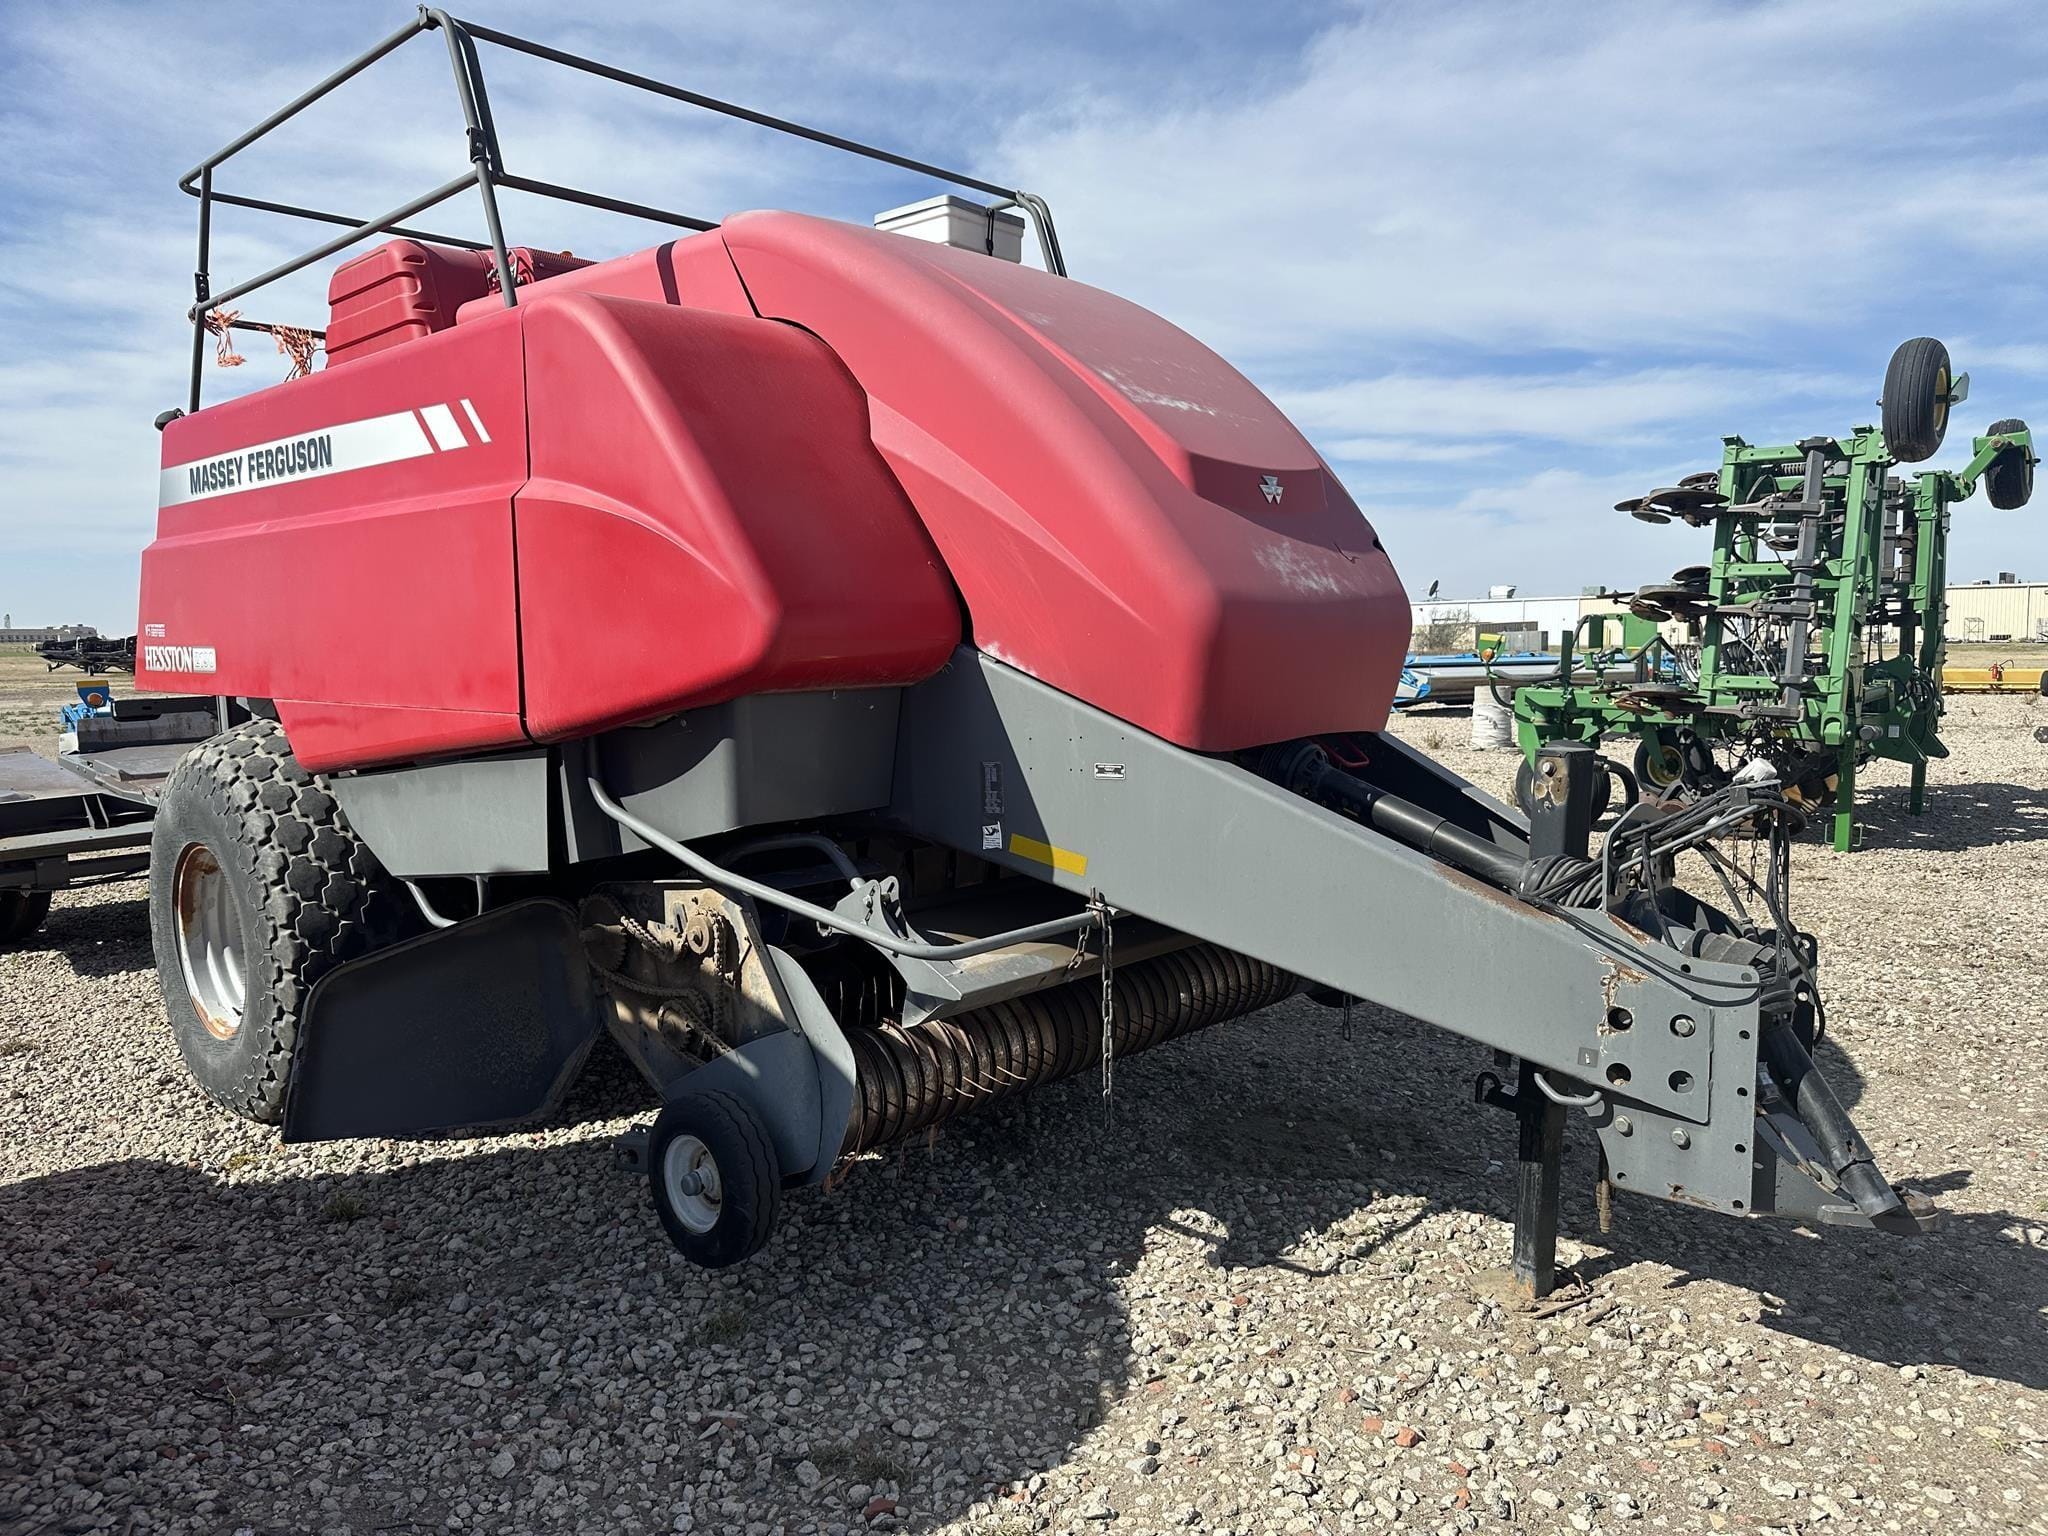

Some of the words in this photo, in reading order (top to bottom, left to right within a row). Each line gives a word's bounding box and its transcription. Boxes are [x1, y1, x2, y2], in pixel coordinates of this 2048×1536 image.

[189, 455, 243, 495] MASSEY
[247, 434, 333, 482] FERGUSON
[144, 645, 193, 673] HESSTON
